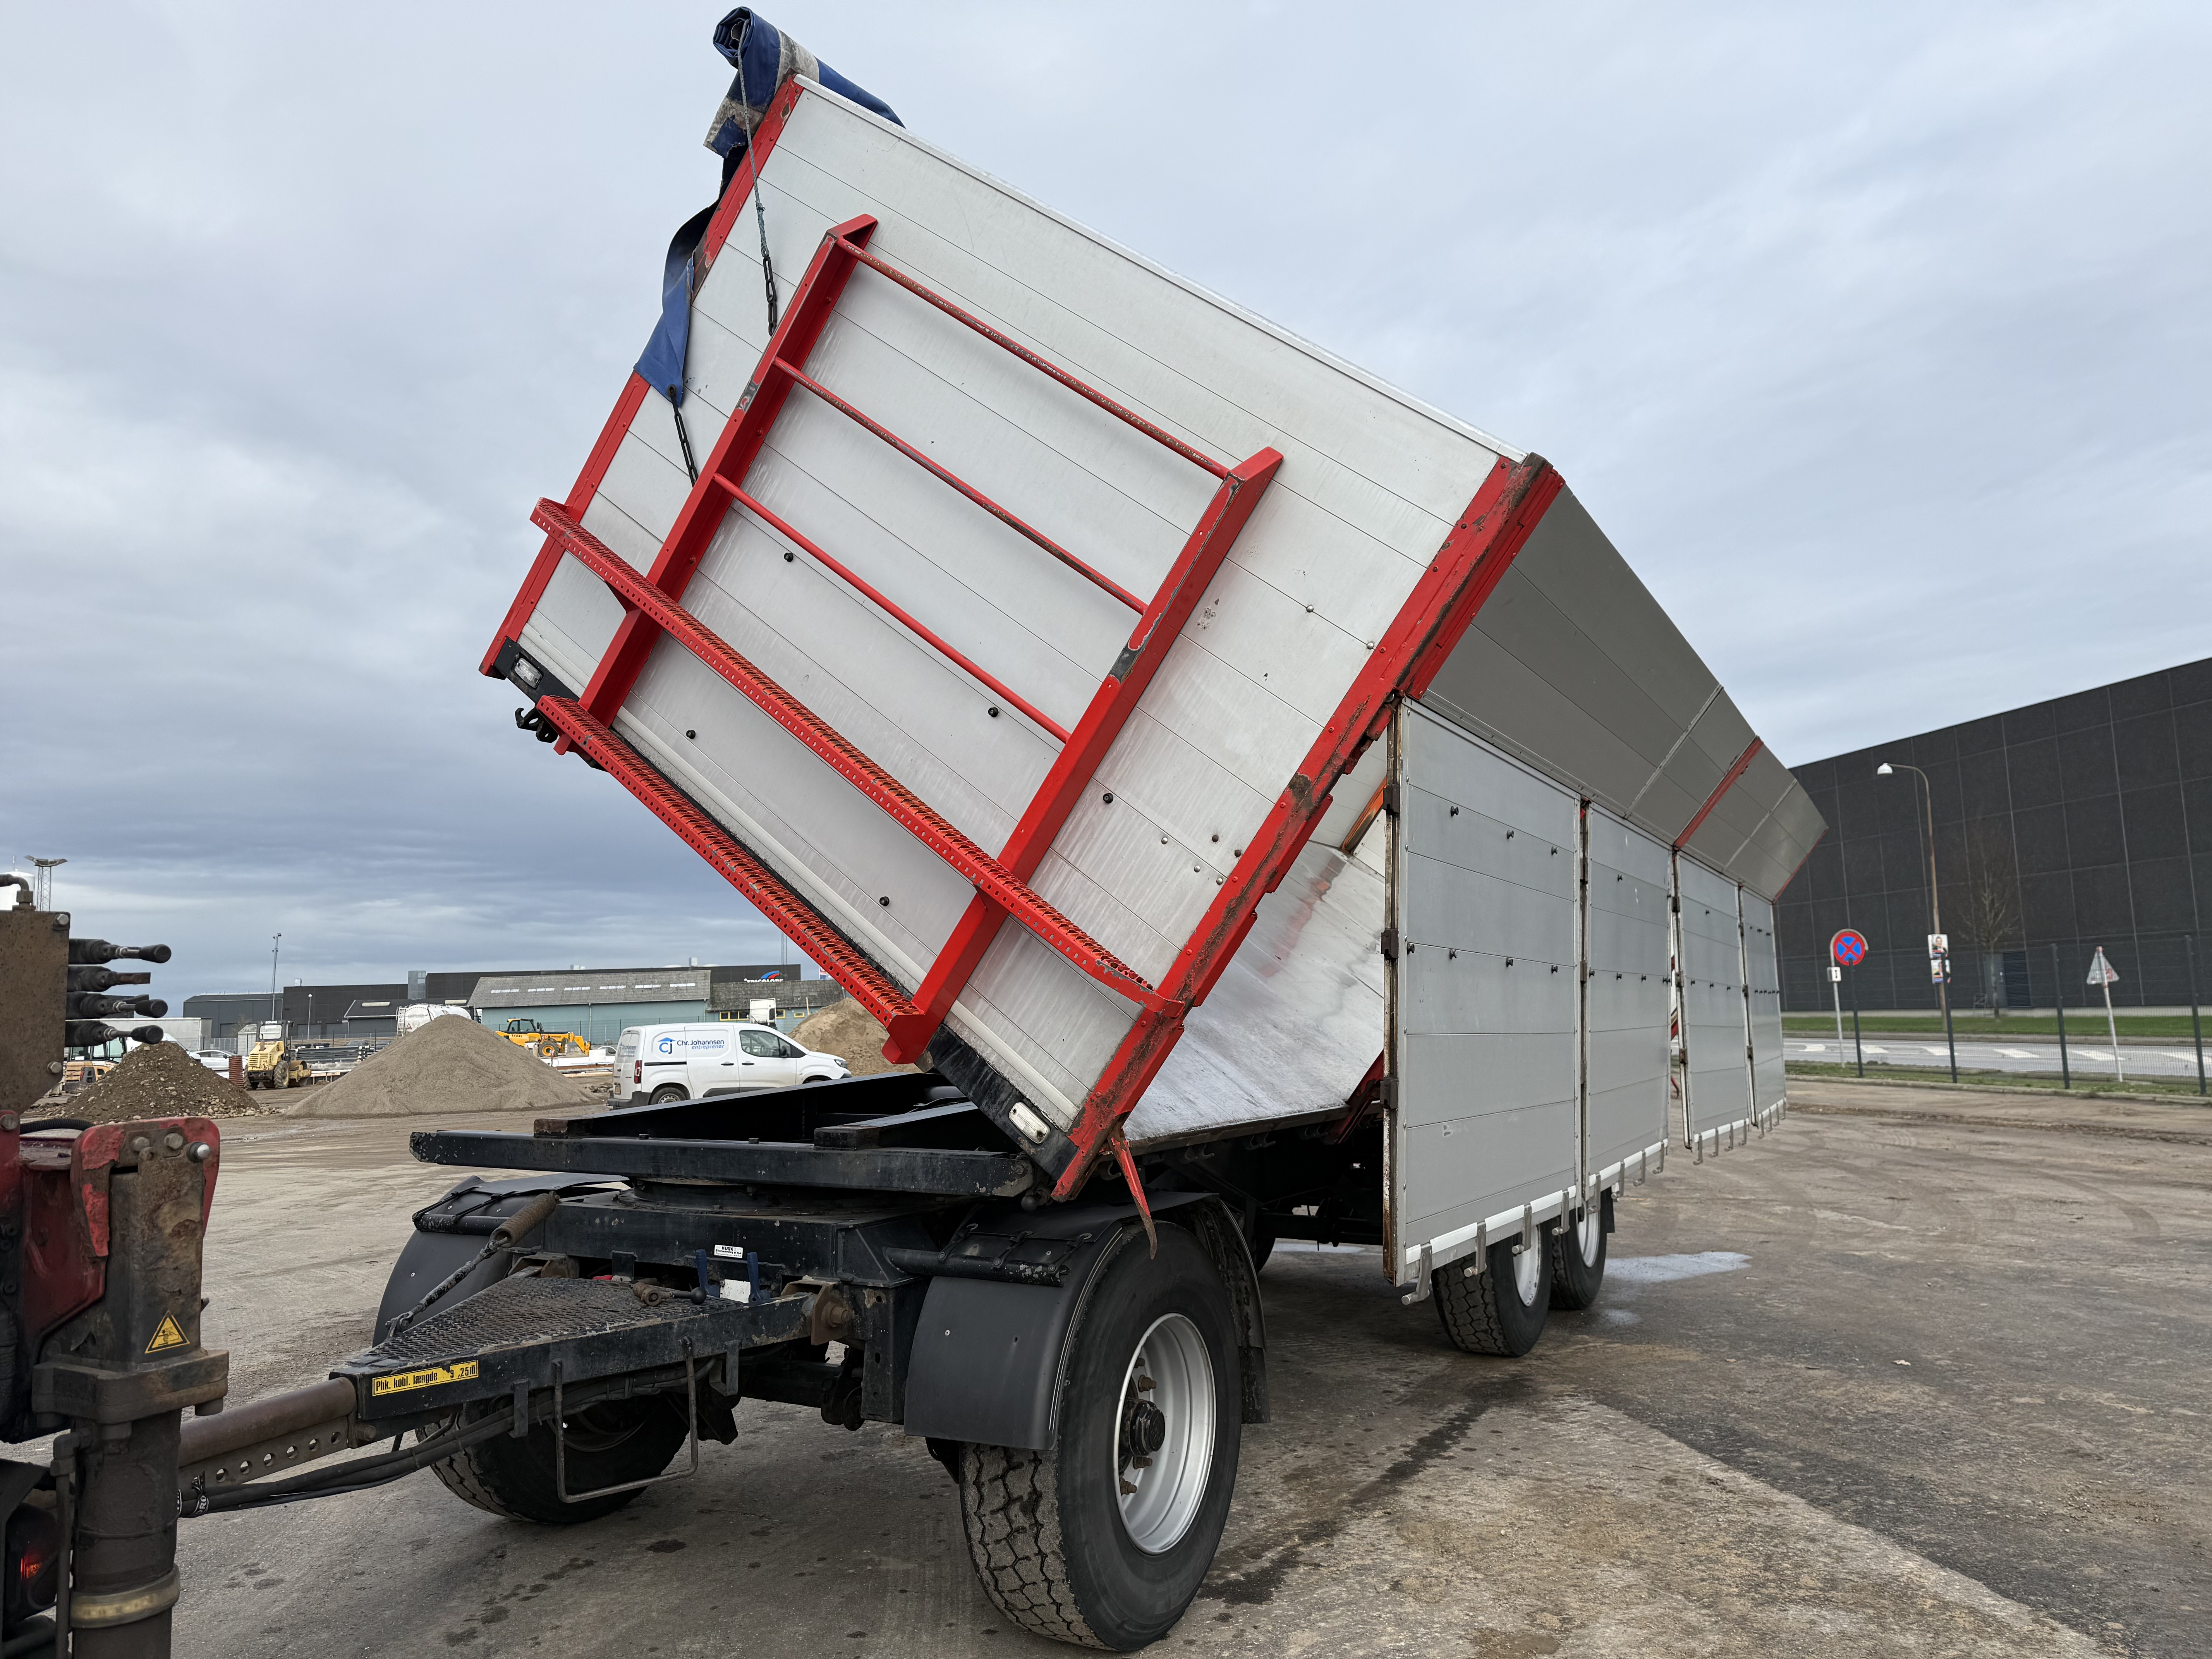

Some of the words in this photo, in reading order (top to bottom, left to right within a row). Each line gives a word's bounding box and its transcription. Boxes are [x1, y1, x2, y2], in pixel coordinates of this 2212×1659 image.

[376, 1379, 391, 1391] Phk.
[394, 1376, 410, 1388] kobl.
[413, 1371, 437, 1384] længde
